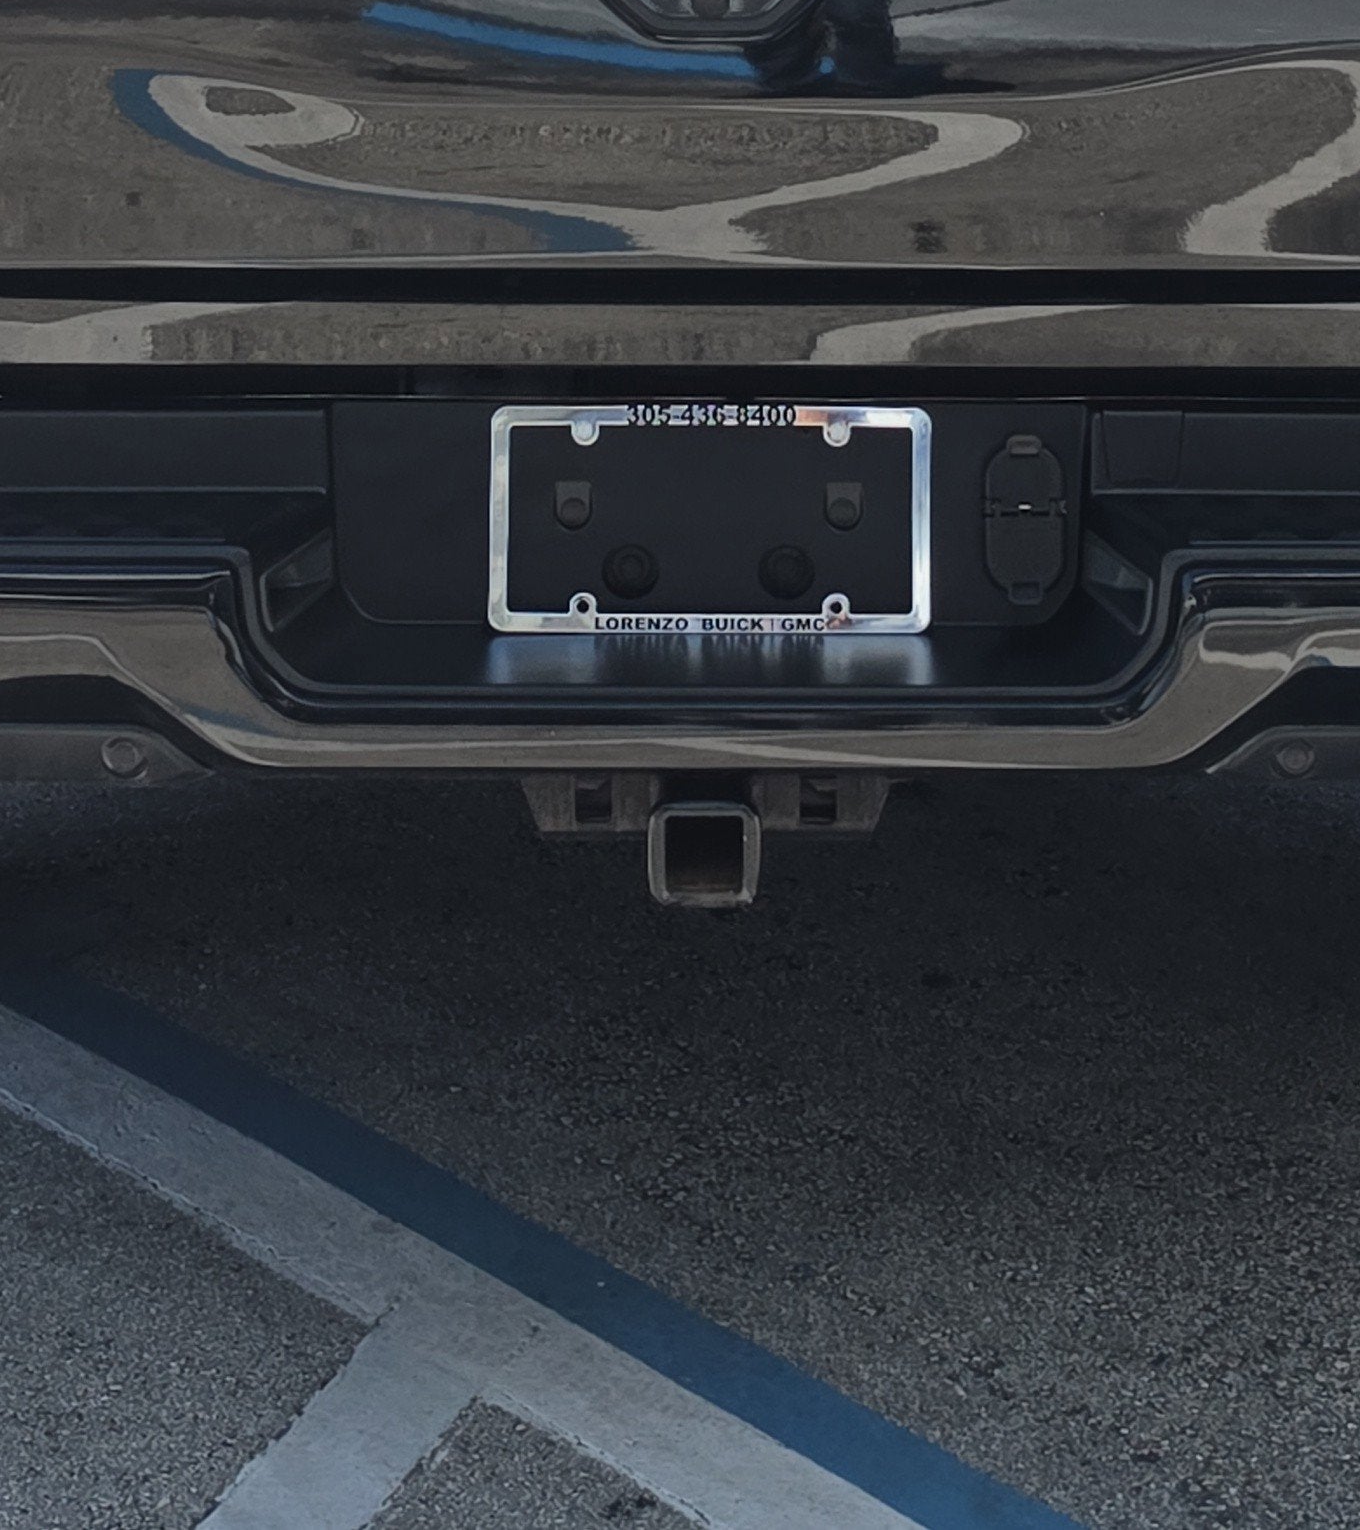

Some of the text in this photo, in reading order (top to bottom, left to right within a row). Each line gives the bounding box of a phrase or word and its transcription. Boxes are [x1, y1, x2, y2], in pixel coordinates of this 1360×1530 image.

[626, 405, 797, 426] 305-436-8400
[594, 617, 825, 632] LORENZO BUICK GMC
